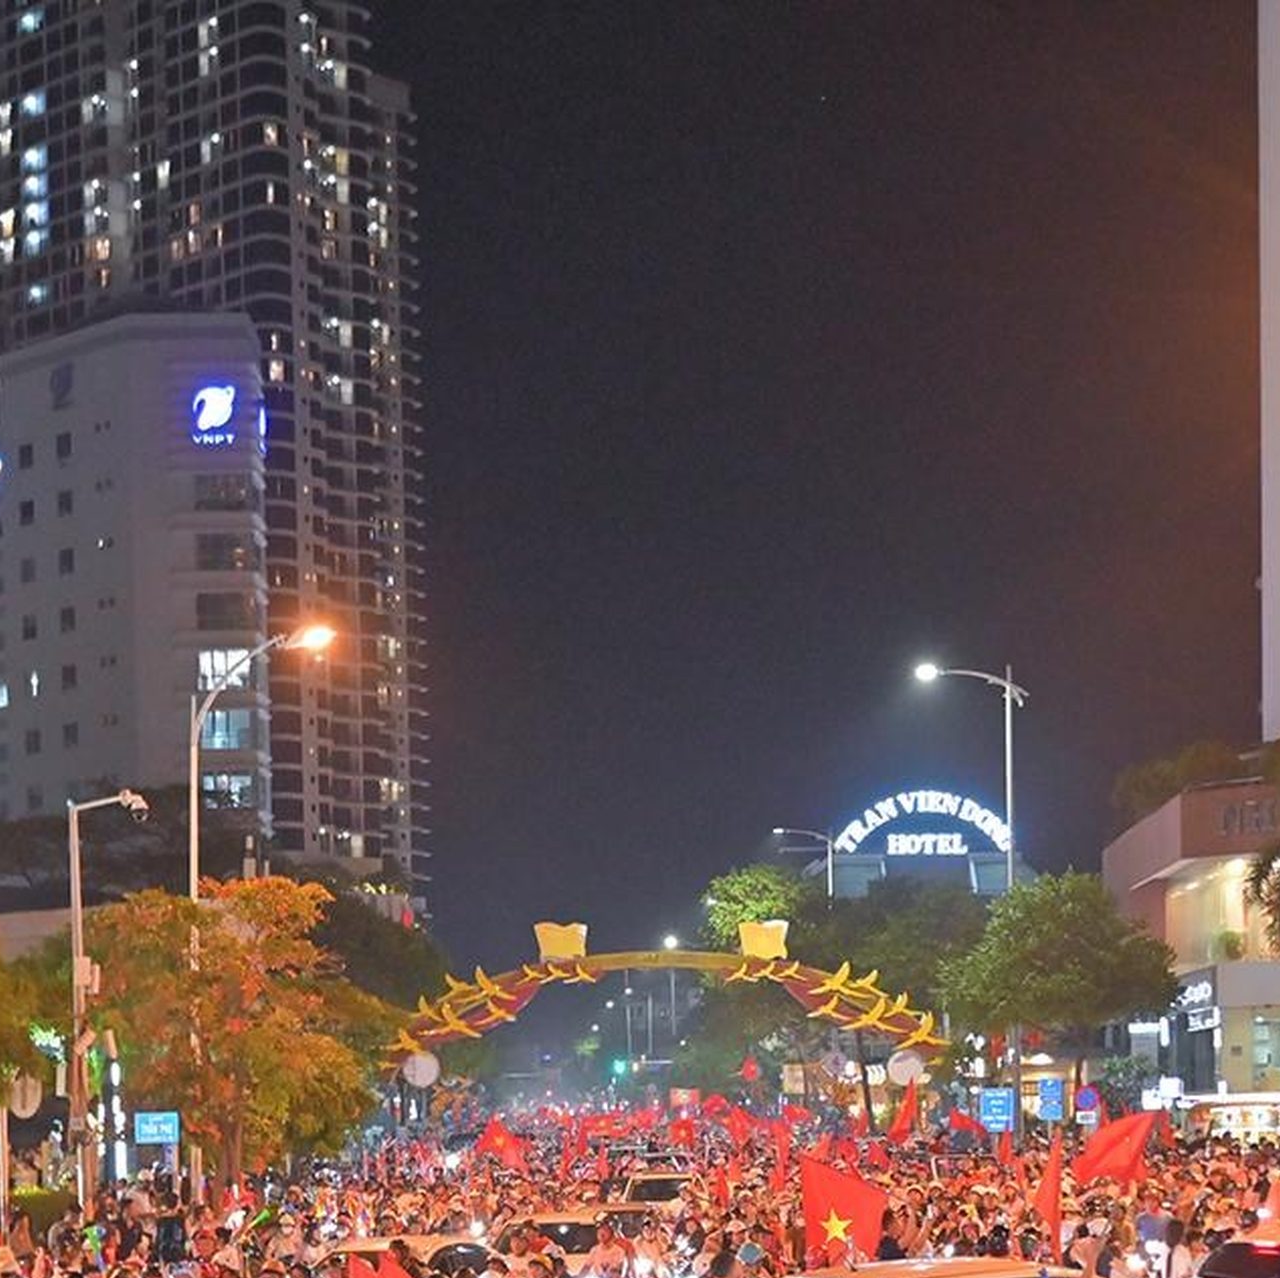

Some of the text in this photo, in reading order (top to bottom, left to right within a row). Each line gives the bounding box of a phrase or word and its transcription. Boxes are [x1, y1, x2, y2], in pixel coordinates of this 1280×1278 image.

[192, 433, 235, 445] VNPT
[834, 797, 899, 853] TRAN
[896, 790, 962, 815] VIEN
[887, 834, 968, 855] HOTEL
